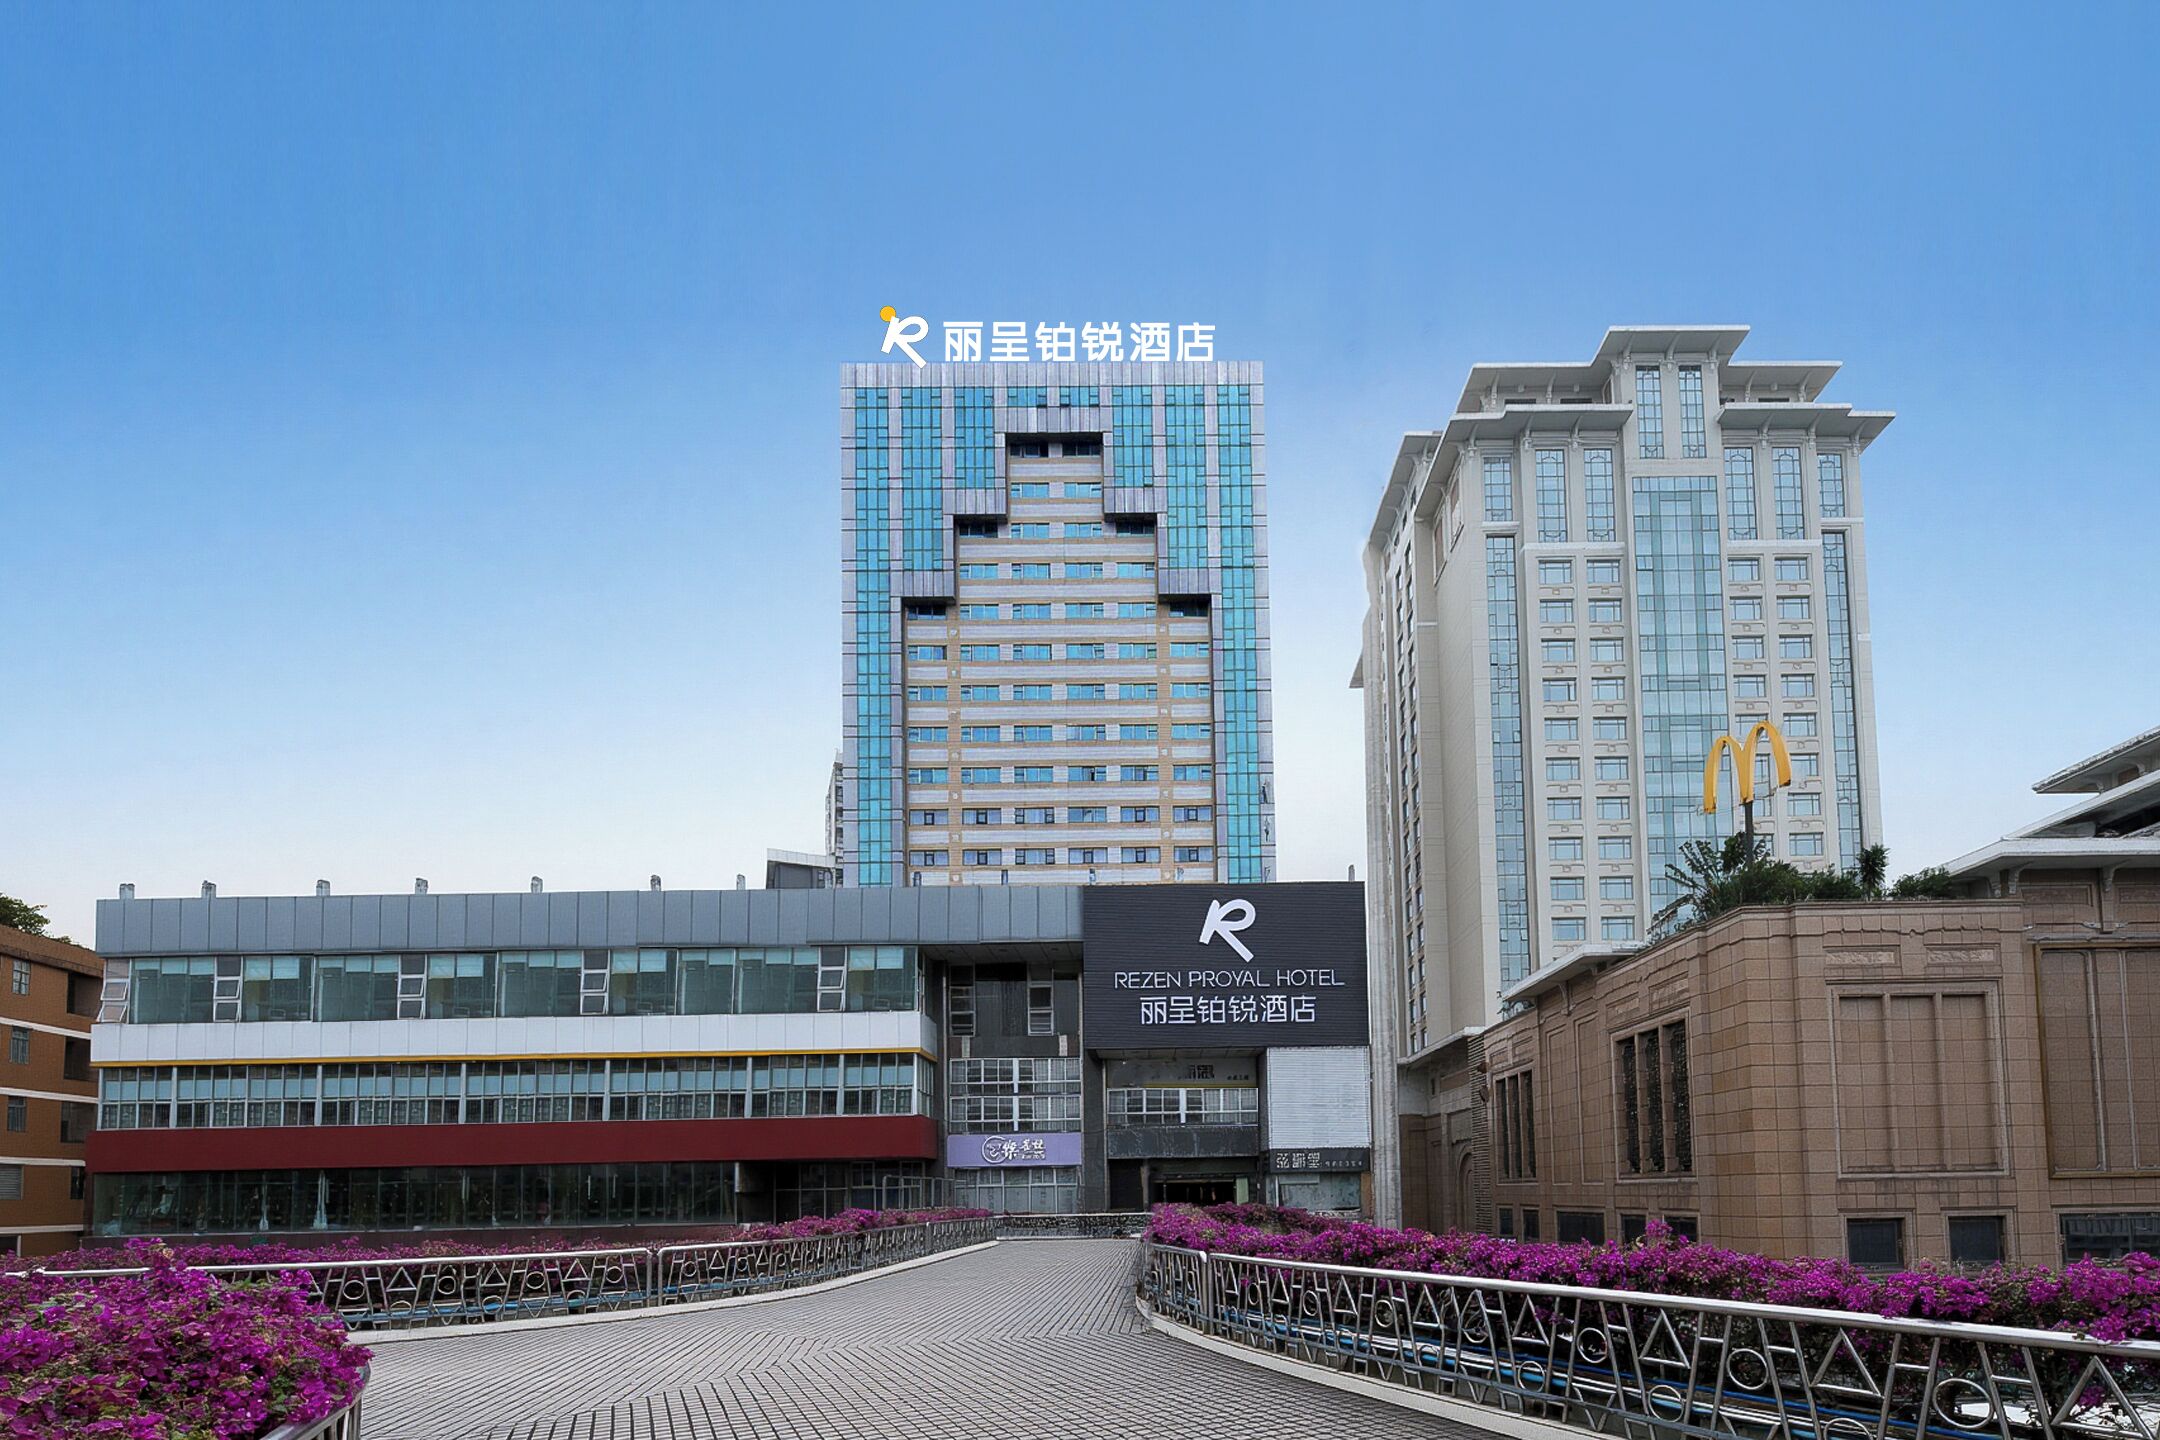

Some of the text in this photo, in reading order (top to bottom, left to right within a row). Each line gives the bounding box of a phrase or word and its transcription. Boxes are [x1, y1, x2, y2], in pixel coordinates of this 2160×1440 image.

[943, 321, 1216, 362] 丽呈铂锐酒店
[1114, 969, 1345, 989] REZEN PROYAL HOTEL
[1139, 995, 1317, 1025] 丽呈铂锐酒店
